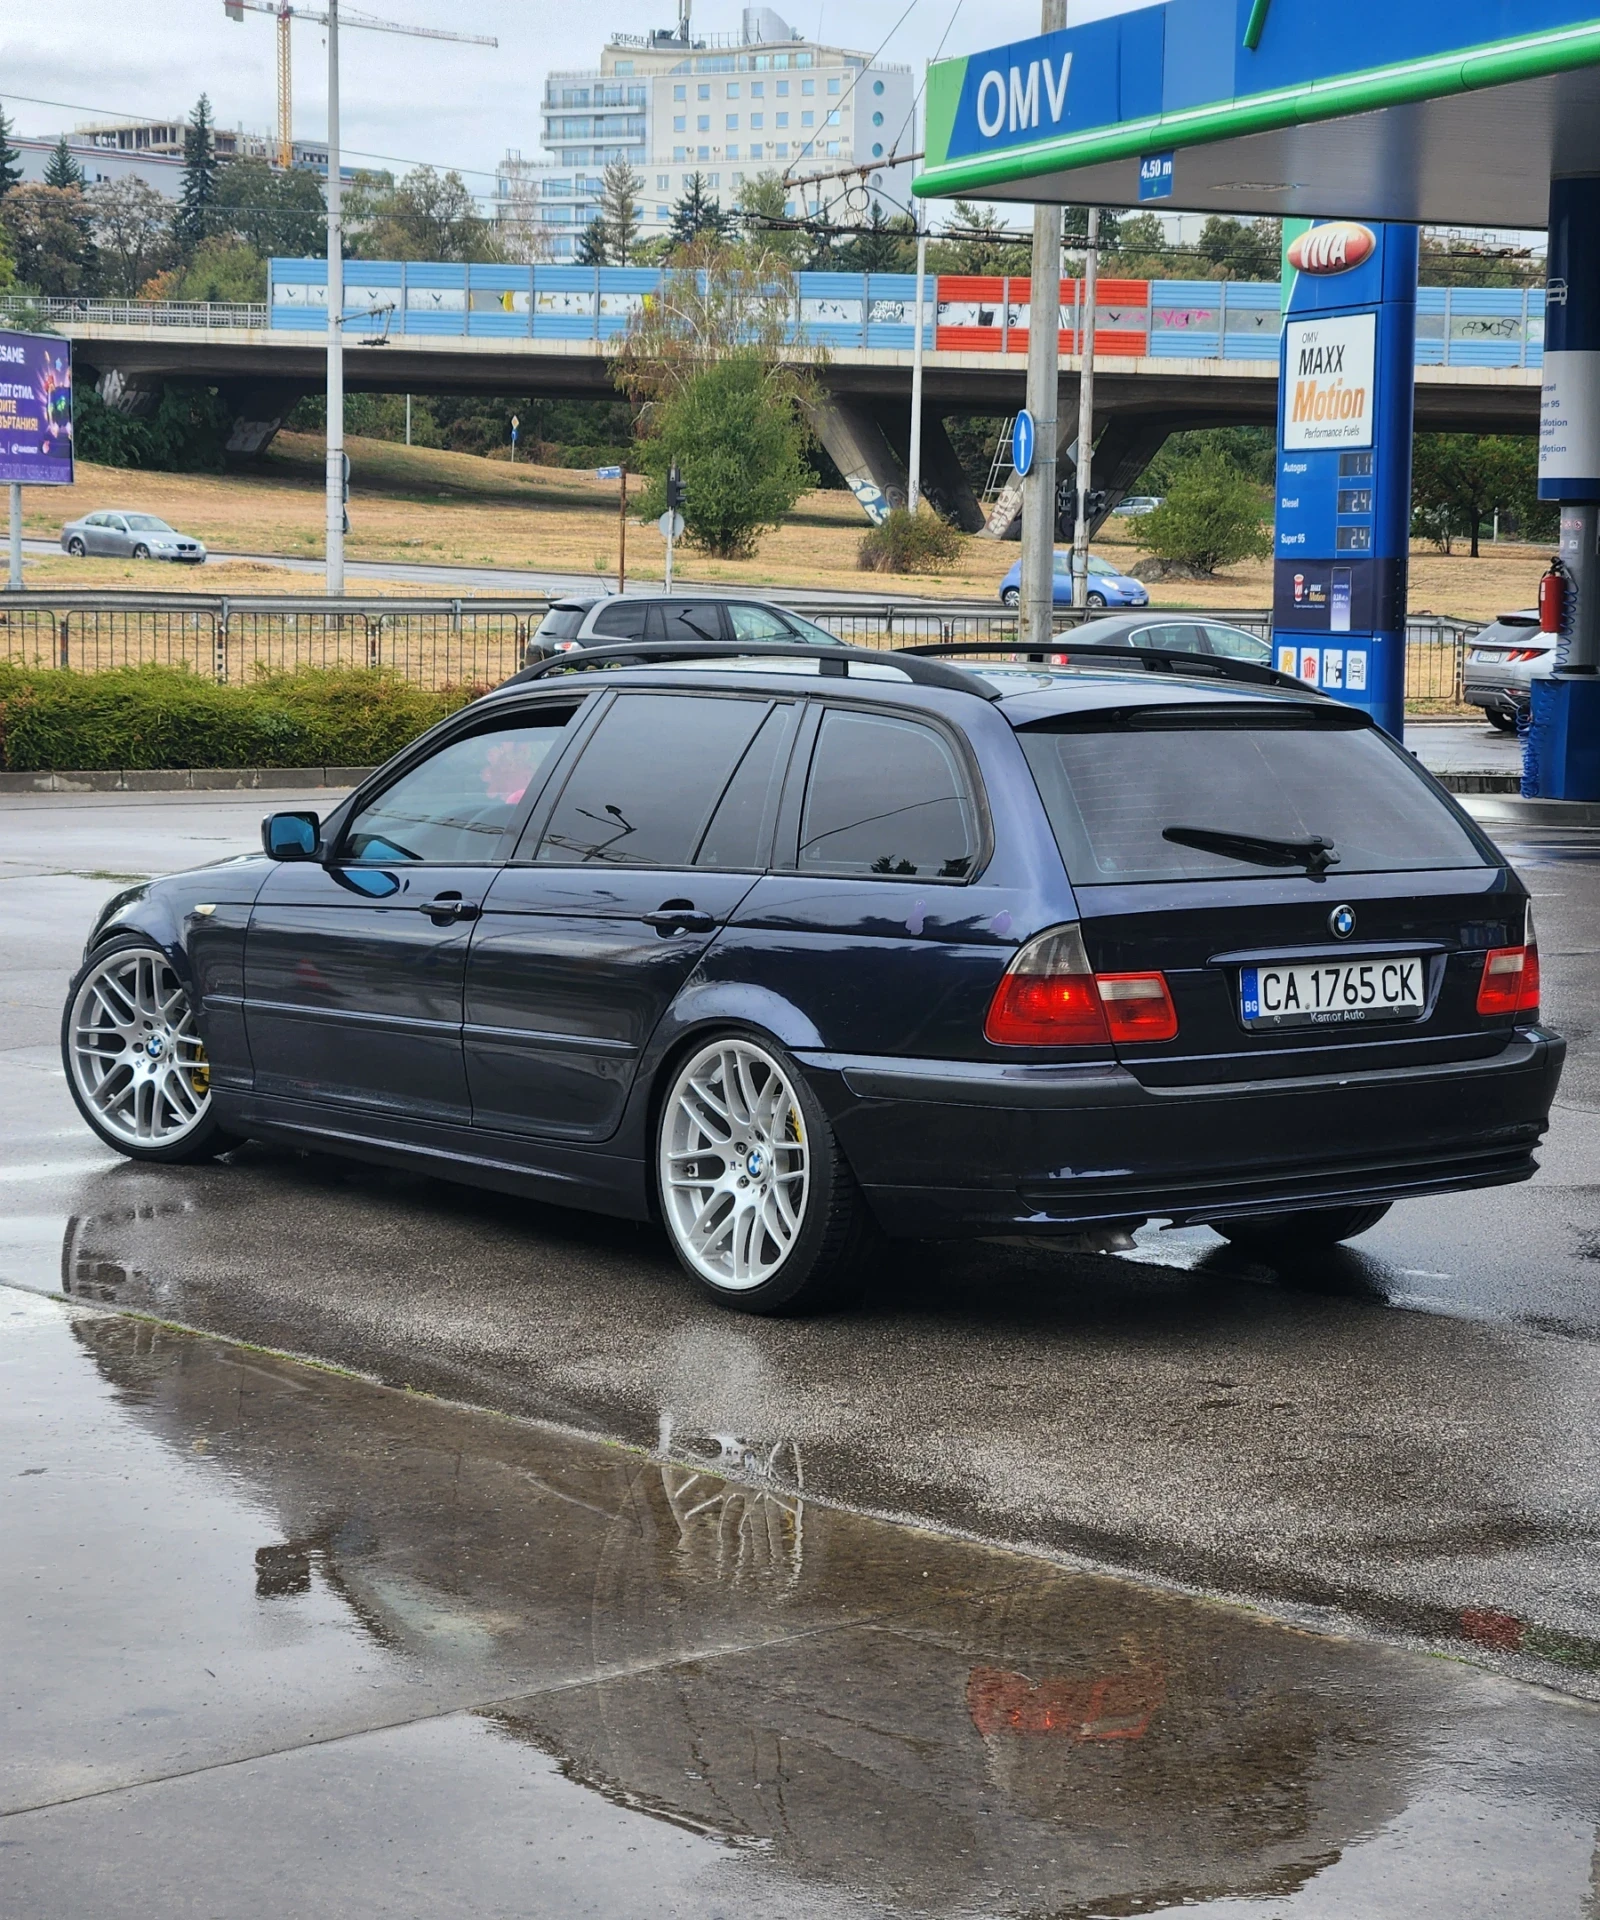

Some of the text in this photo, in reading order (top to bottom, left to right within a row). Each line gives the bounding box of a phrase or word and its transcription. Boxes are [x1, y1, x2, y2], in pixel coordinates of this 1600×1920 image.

[977, 52, 1073, 137] OMV
[1141, 160, 1171, 178] 4.50 m
[1300, 228, 1348, 269] VIVA
[1301, 332, 1318, 344] OMV
[1299, 344, 1345, 376] MAXX
[1292, 378, 1365, 423] Motion
[1551, 400, 1560, 408] 95
[1304, 425, 1360, 439] Performance Fuels
[1283, 462, 1307, 474] Autogas
[1282, 498, 1299, 508] Diesel
[1281, 533, 1297, 545] Super
[1297, 533, 1305, 543] 95
[1245, 963, 1417, 1013] BG CA 1765 CK
[1343, 1010, 1365, 1021] Auto
